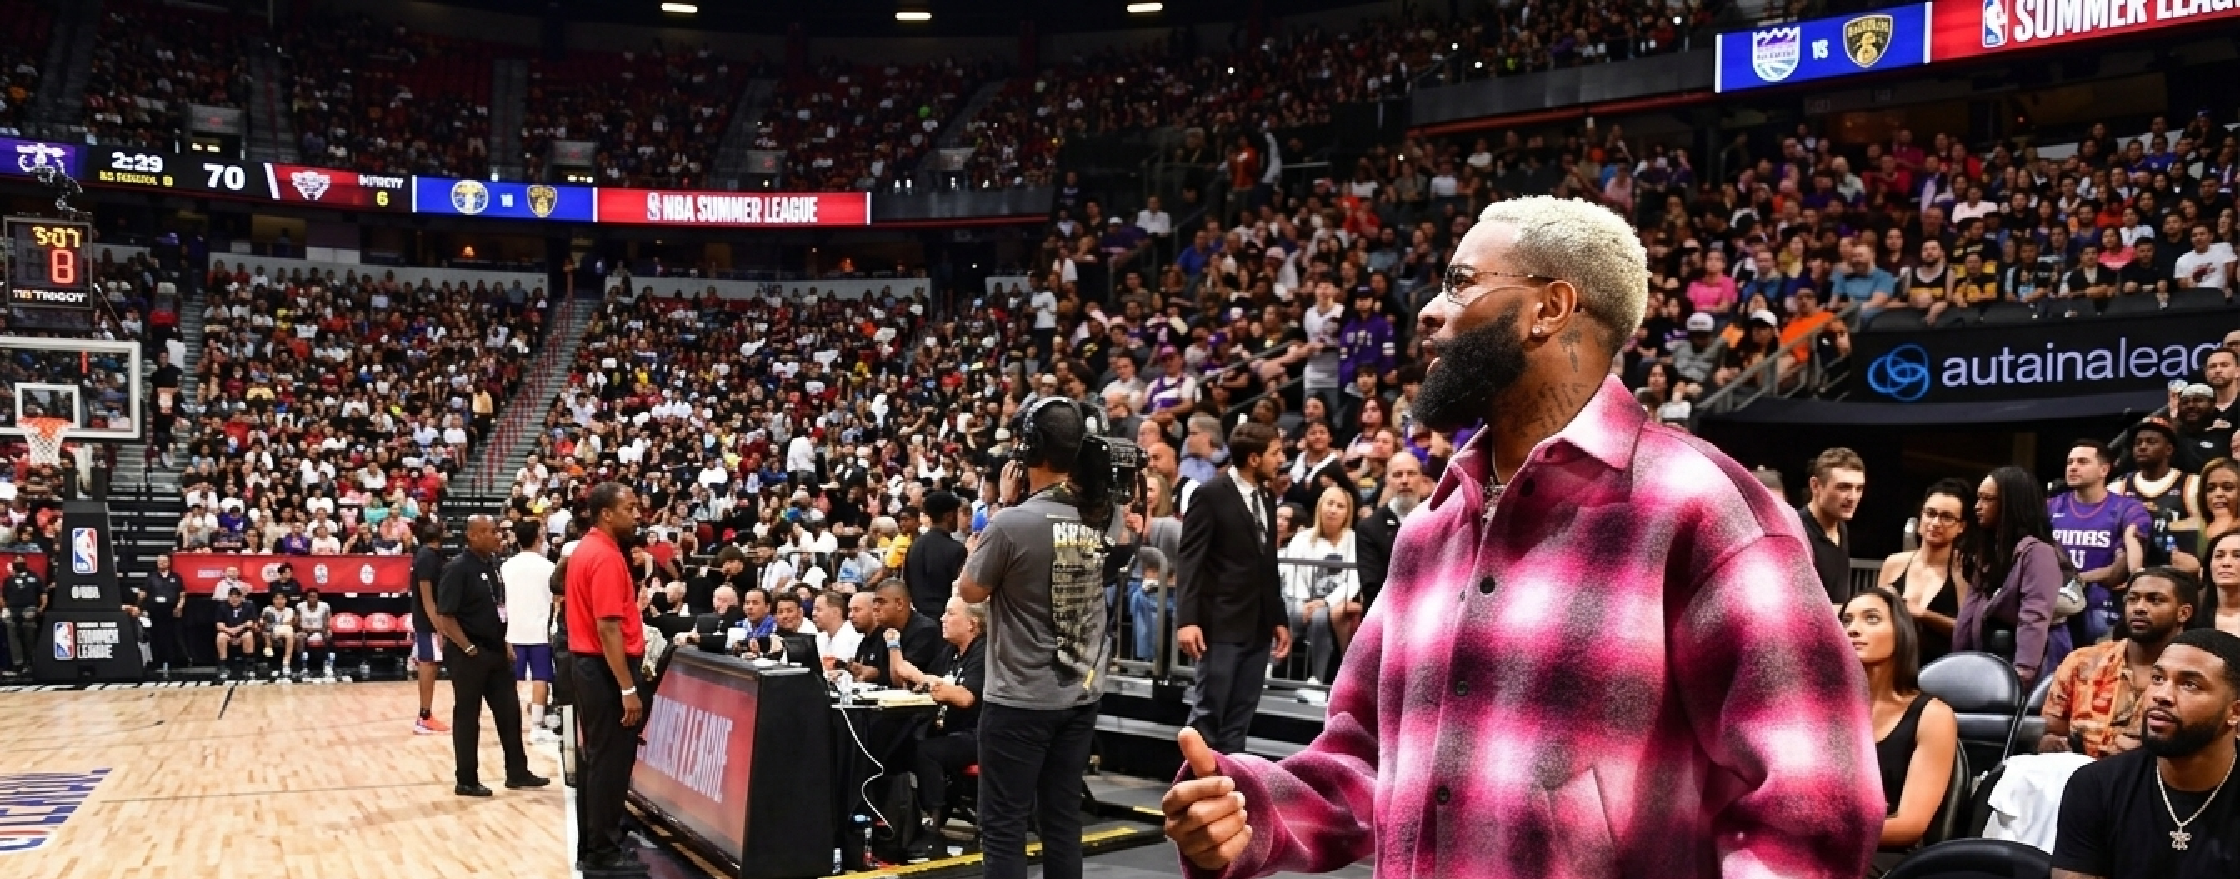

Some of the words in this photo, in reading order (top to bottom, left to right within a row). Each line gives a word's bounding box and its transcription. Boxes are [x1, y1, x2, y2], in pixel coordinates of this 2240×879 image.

[111, 151, 164, 173] 2:29
[203, 162, 246, 191] 70
[376, 190, 389, 207] 6
[662, 194, 696, 222] NBA
[697, 194, 763, 224] SUMMER
[764, 196, 819, 224] LEAGUE
[51, 249, 75, 285] 8
